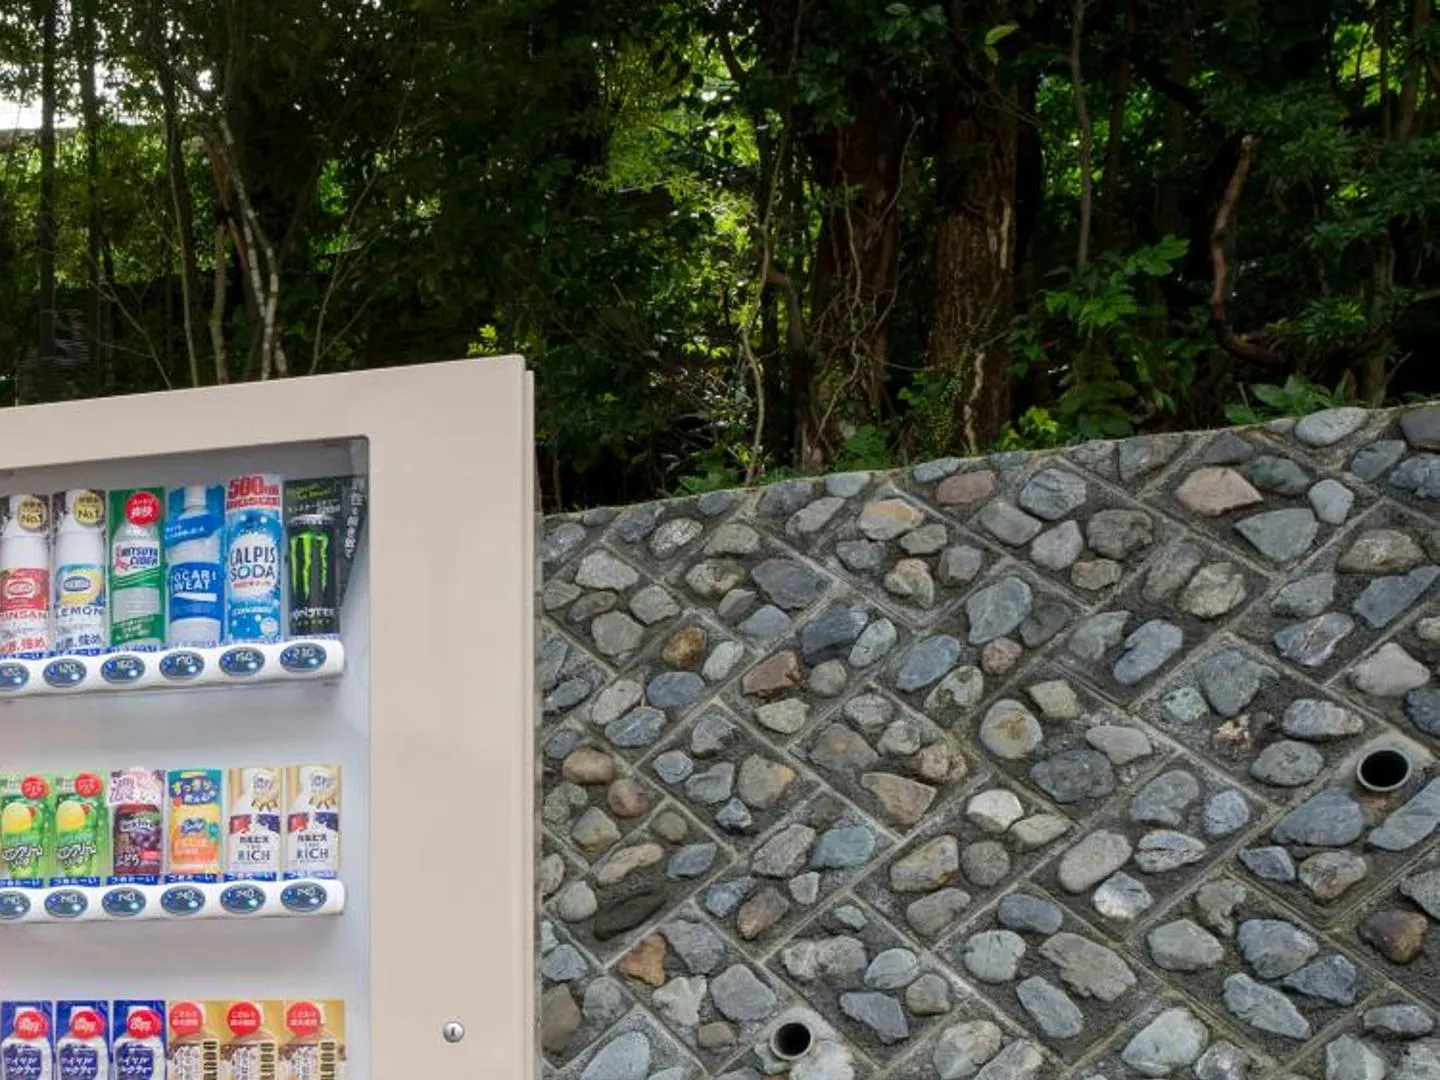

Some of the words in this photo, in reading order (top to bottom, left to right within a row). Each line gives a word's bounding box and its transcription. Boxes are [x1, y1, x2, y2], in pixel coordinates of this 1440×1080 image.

[230, 547, 275, 566] CALPIS
[230, 566, 275, 581] SODA
[237, 850, 271, 861] RICH
[296, 848, 329, 859] RICH
